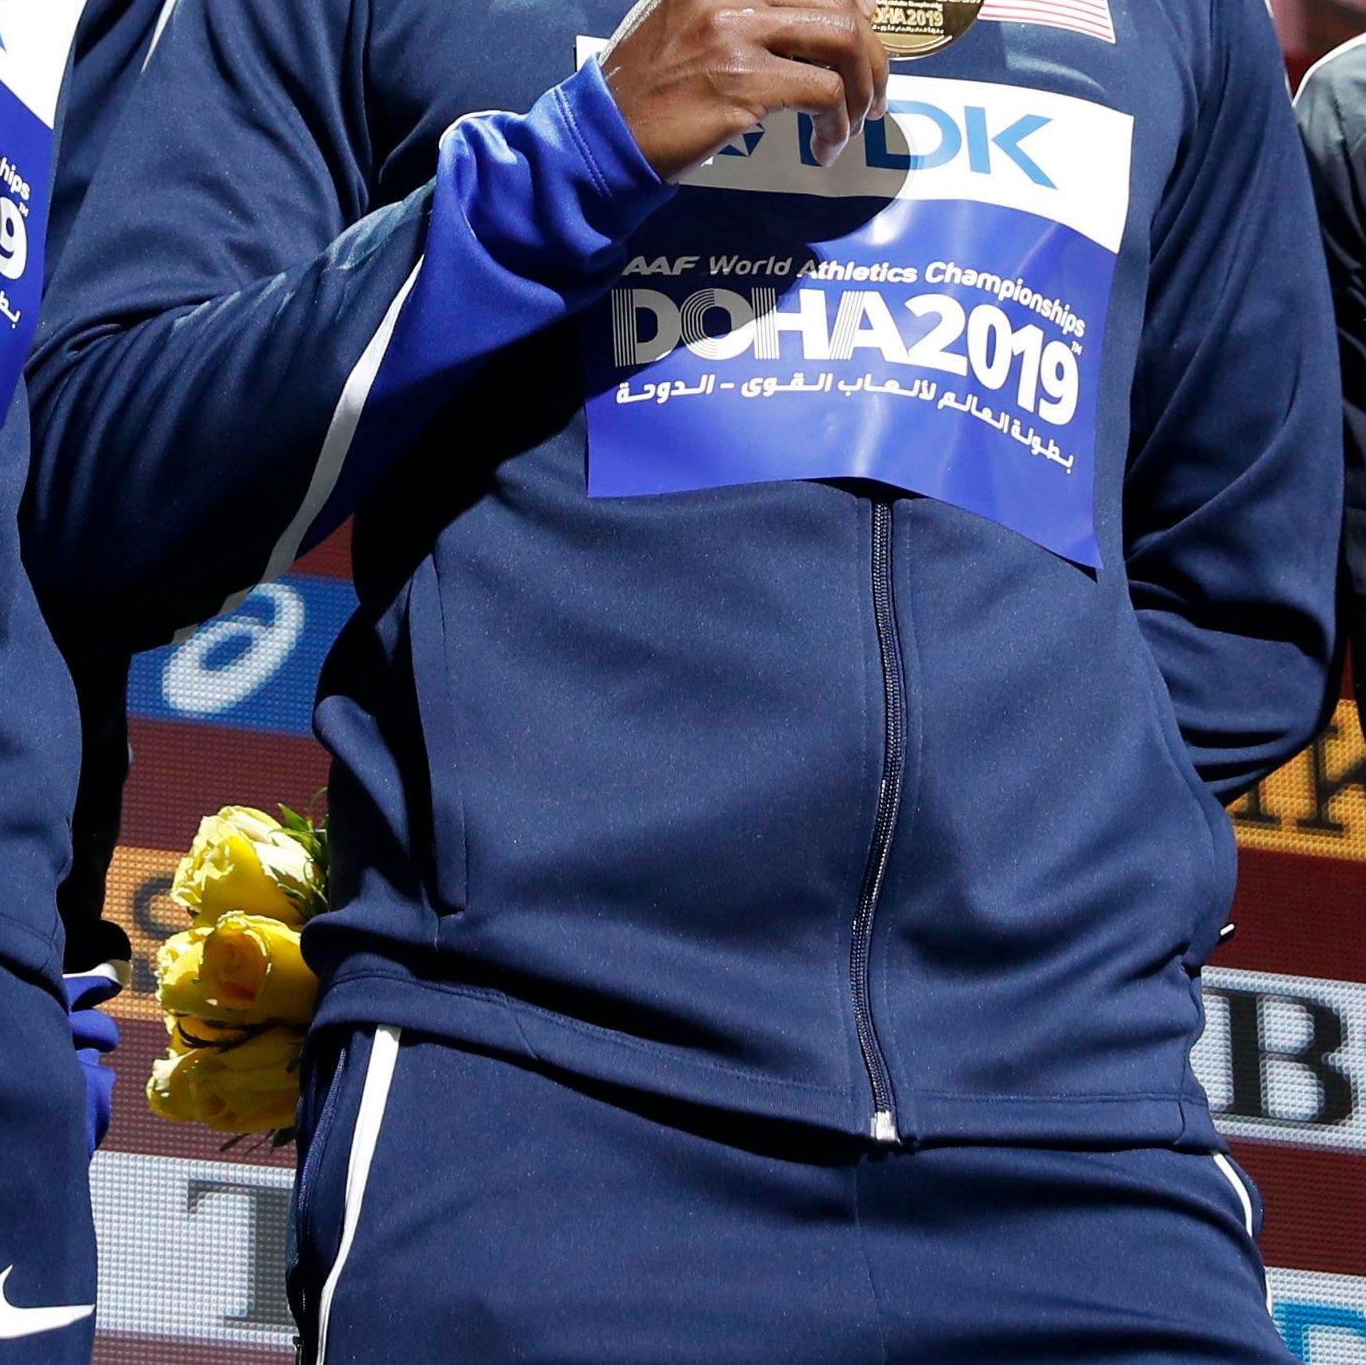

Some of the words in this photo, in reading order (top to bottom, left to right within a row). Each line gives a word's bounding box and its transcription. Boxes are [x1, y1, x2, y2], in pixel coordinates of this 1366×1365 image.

[709, 254, 793, 277] World
[797, 259, 919, 284] Athletics
[925, 261, 1086, 338] Championships
[611, 287, 1079, 426] DOHA2019
[615, 374, 716, 405] الدوحة
[937, 391, 1010, 434] العالم
[1011, 418, 1074, 475] بطولة
